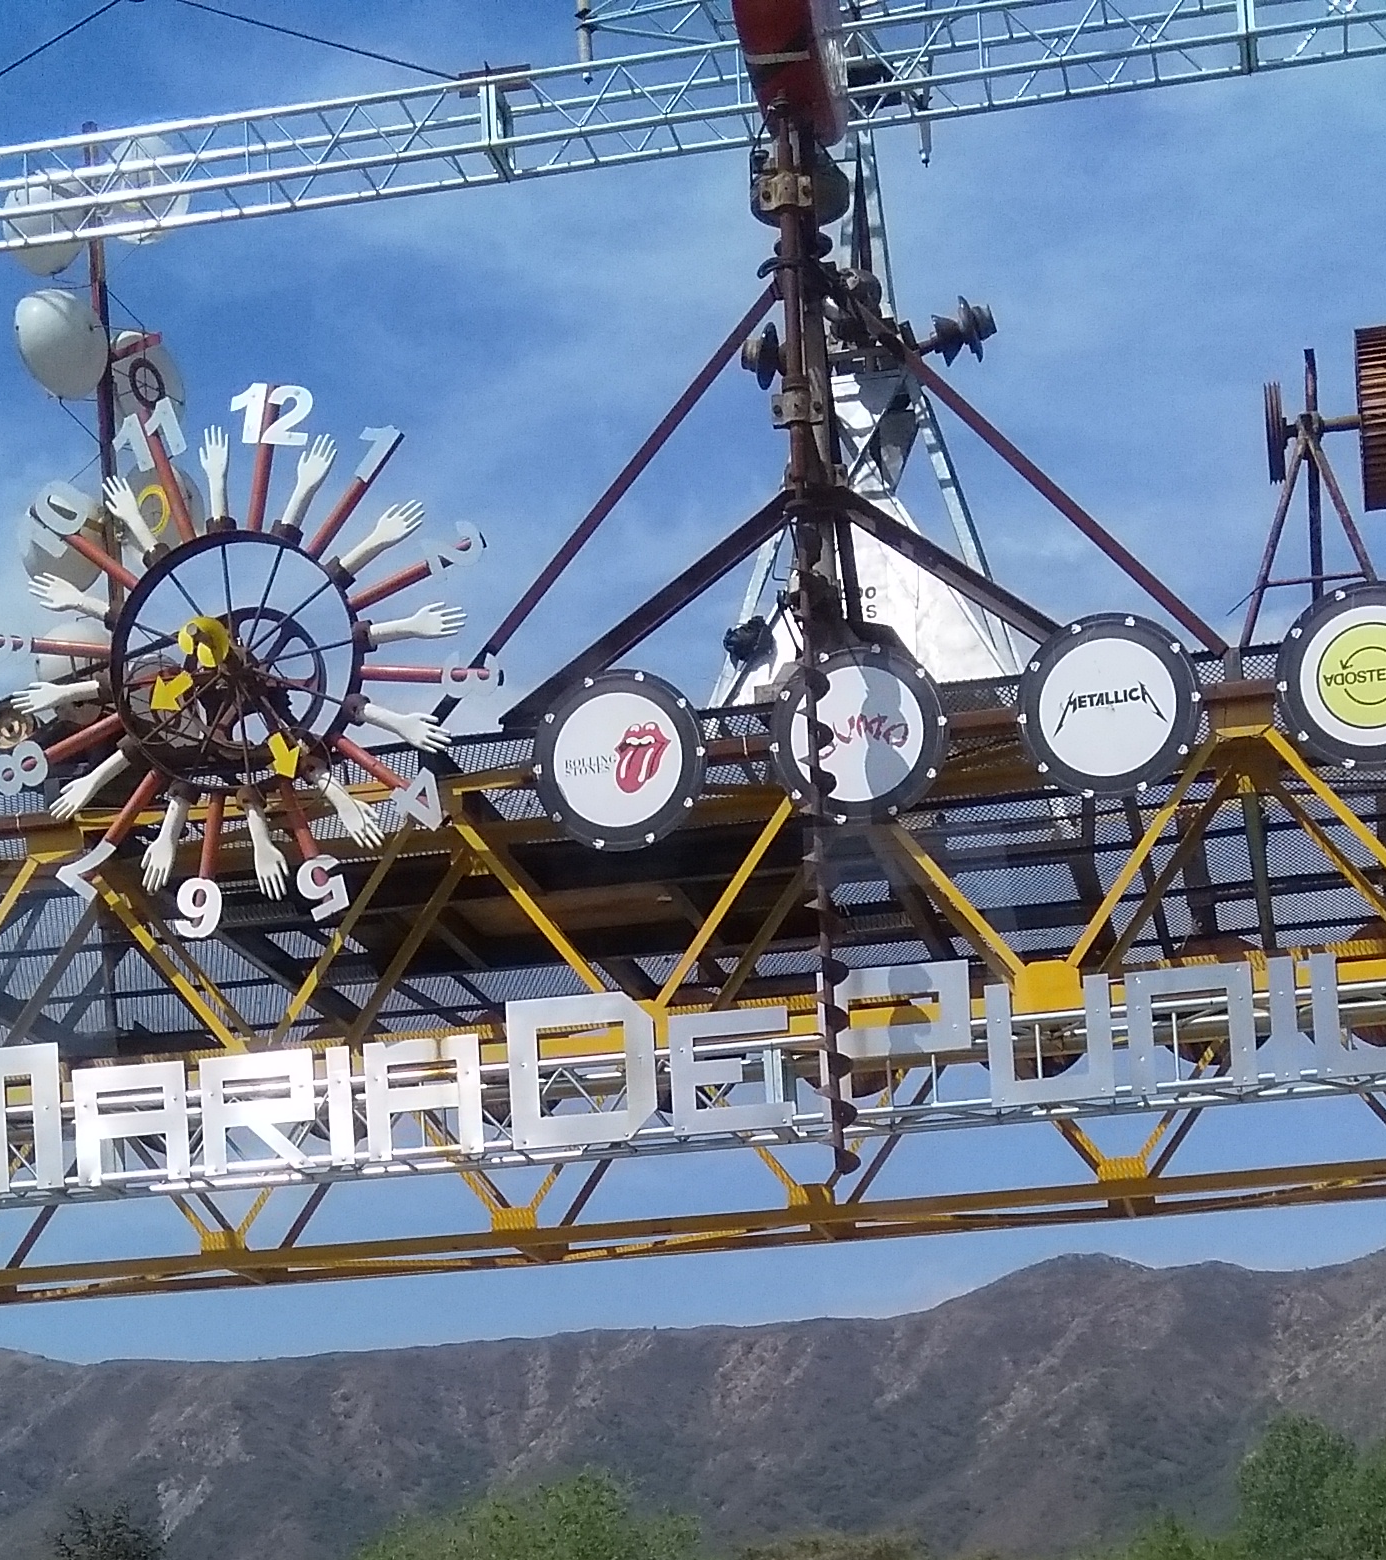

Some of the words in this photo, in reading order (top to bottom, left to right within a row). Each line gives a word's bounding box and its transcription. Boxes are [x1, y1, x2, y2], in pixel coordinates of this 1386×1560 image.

[230, 383, 314, 446] 12
[1053, 681, 1168, 738] METALLICA
[565, 755, 617, 769] ROLLING
[566, 766, 611, 777] STONES
